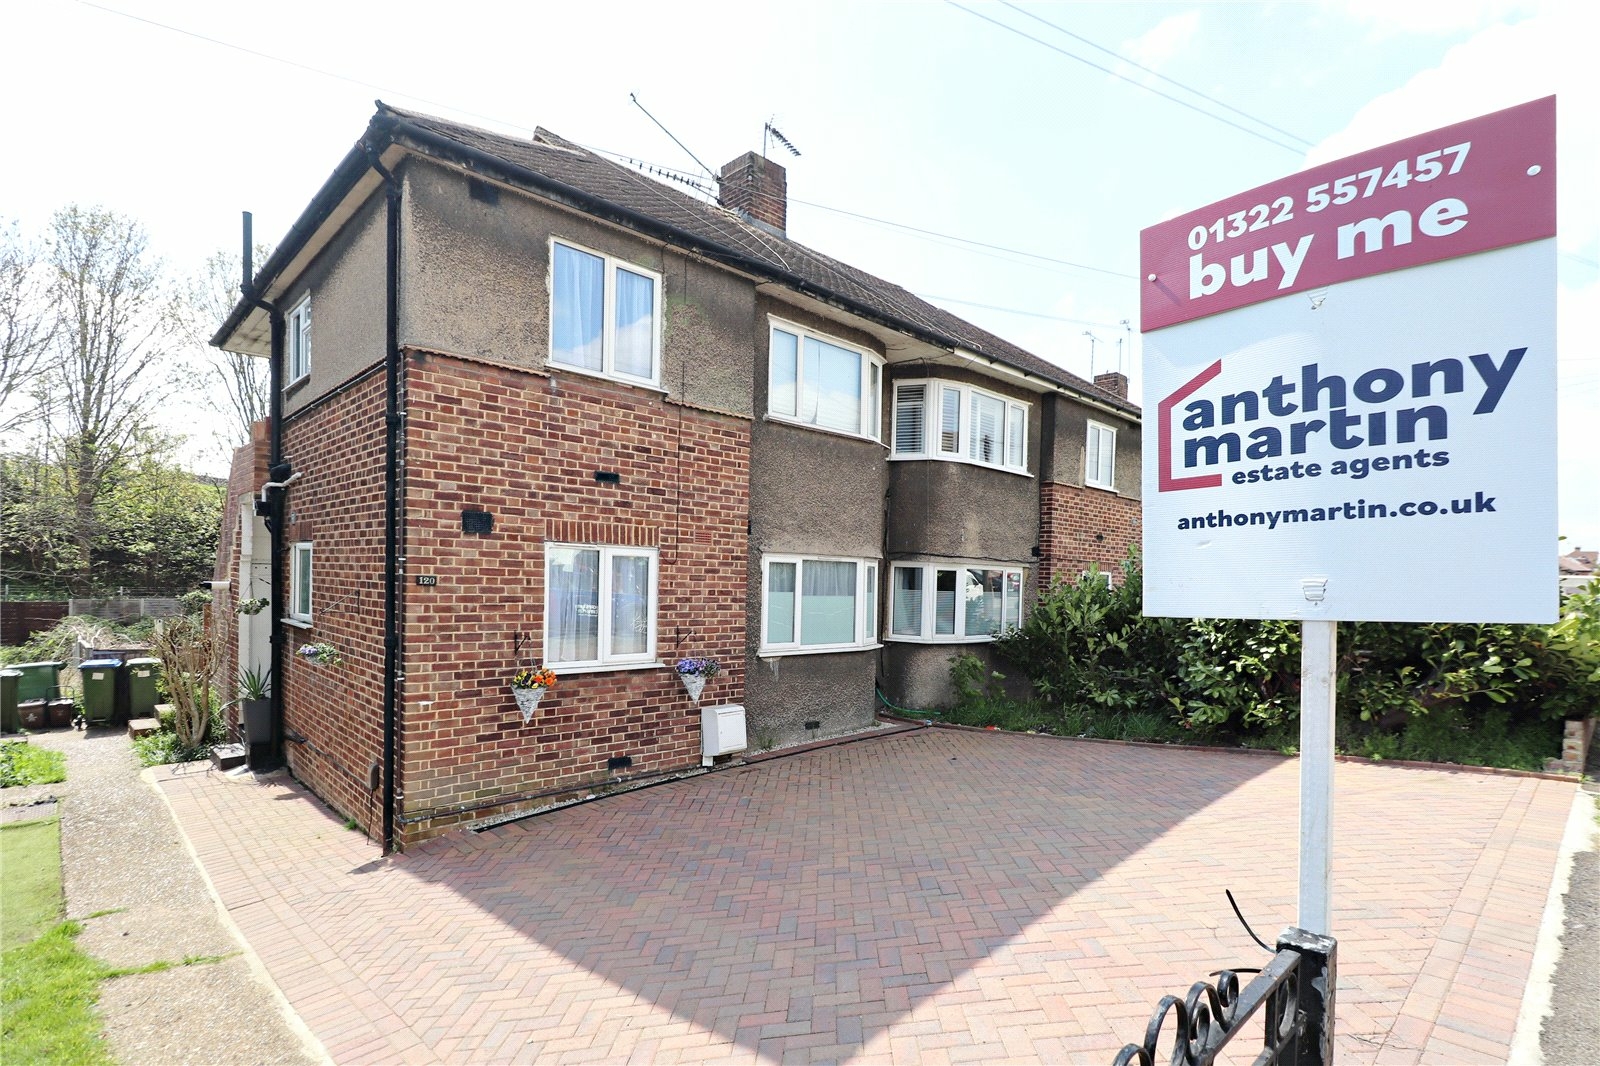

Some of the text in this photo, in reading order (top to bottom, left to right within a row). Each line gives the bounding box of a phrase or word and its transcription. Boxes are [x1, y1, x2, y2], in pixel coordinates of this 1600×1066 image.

[1187, 142, 1471, 251] 01322 557457
[1189, 197, 1469, 299] buy me
[1182, 347, 1528, 431] anthony
[1184, 402, 1448, 468] martin
[1232, 448, 1449, 485] estate agents
[1177, 491, 1496, 530] anthonymartin.co.uk
[419, 576, 435, 584] 120
